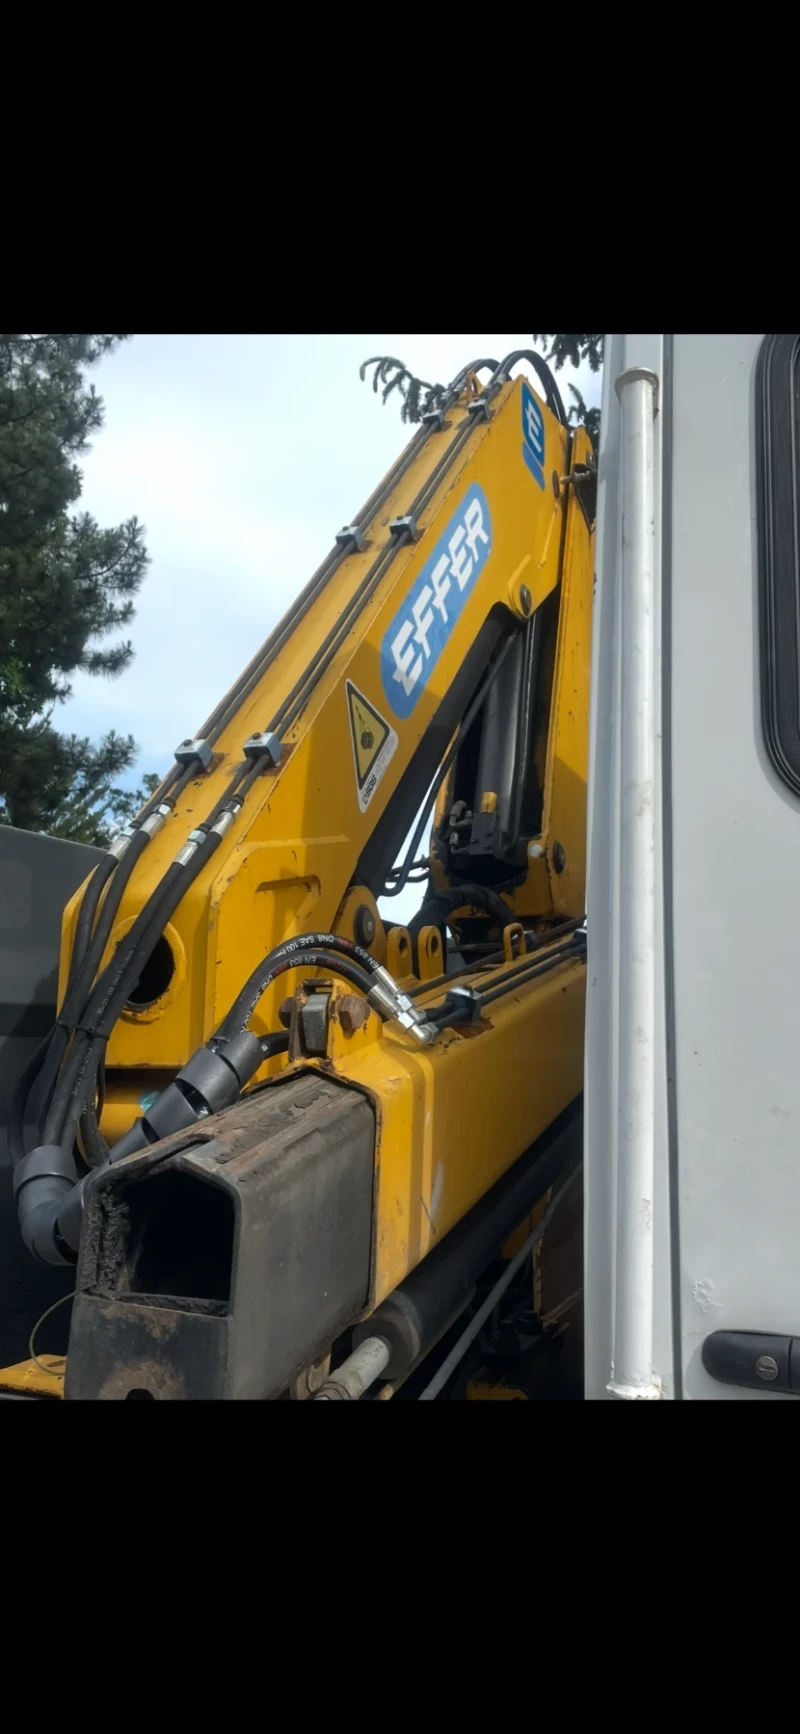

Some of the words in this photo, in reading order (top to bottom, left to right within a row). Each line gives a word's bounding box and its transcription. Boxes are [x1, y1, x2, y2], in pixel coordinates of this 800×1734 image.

[391, 498, 489, 697] EFFER
[299, 934, 315, 946] SAE
[317, 934, 334, 943] DN8
[354, 945, 369, 960] 853
[367, 957, 379, 969] EN
